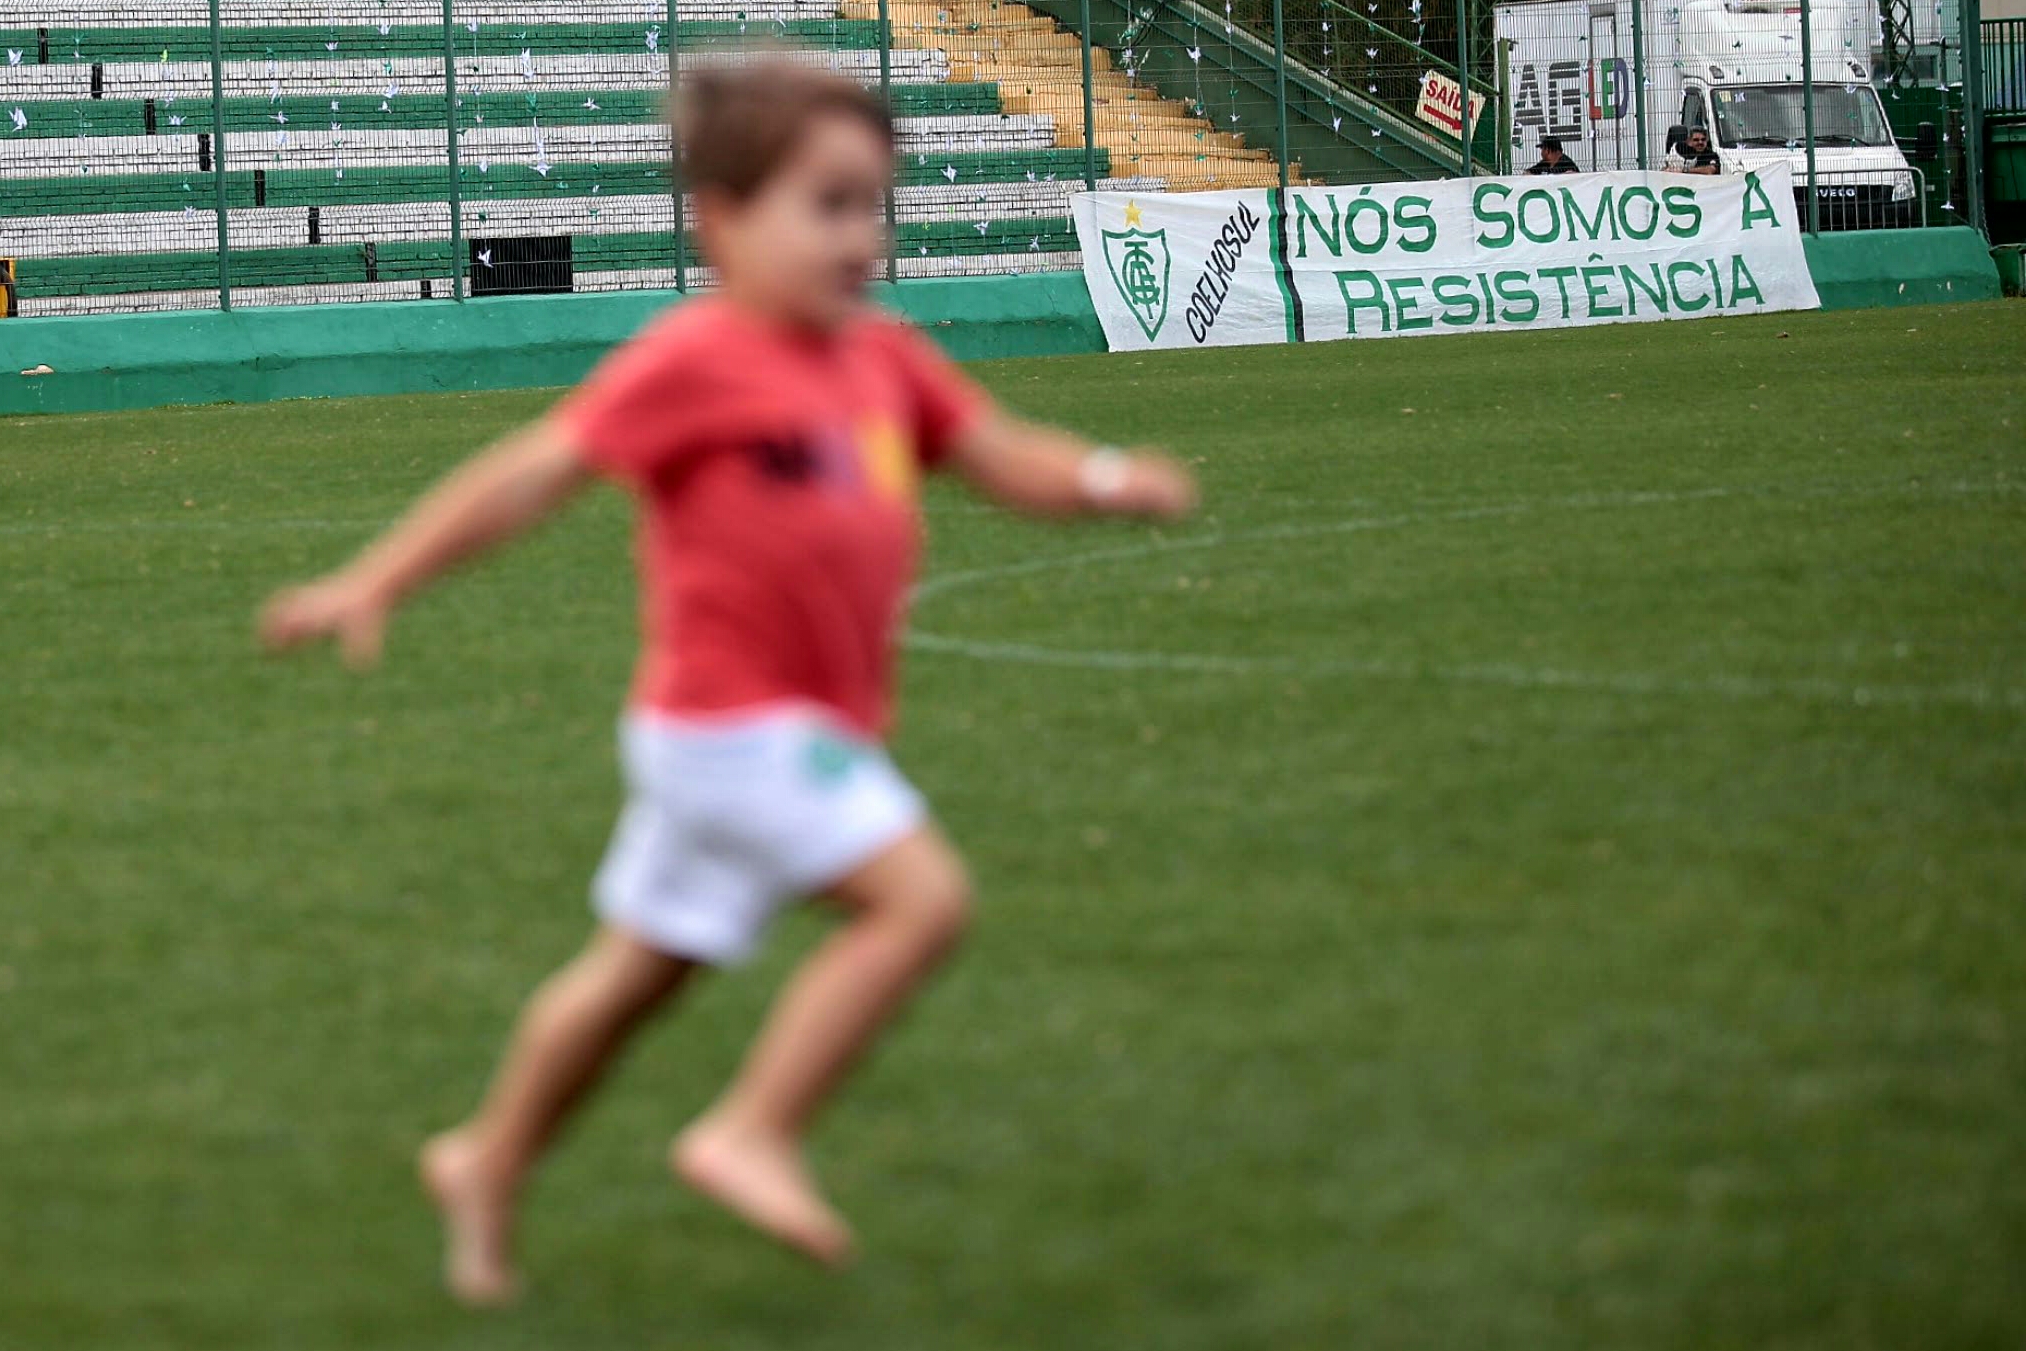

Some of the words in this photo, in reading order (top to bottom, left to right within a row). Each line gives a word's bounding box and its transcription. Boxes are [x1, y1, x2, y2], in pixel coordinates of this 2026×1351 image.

[1293, 186, 1437, 258] NÓS
[1472, 182, 1702, 249] SOMOS
[1186, 200, 1260, 344] COELHOSUL
[1334, 253, 1766, 335] RESISTÊNCIA
